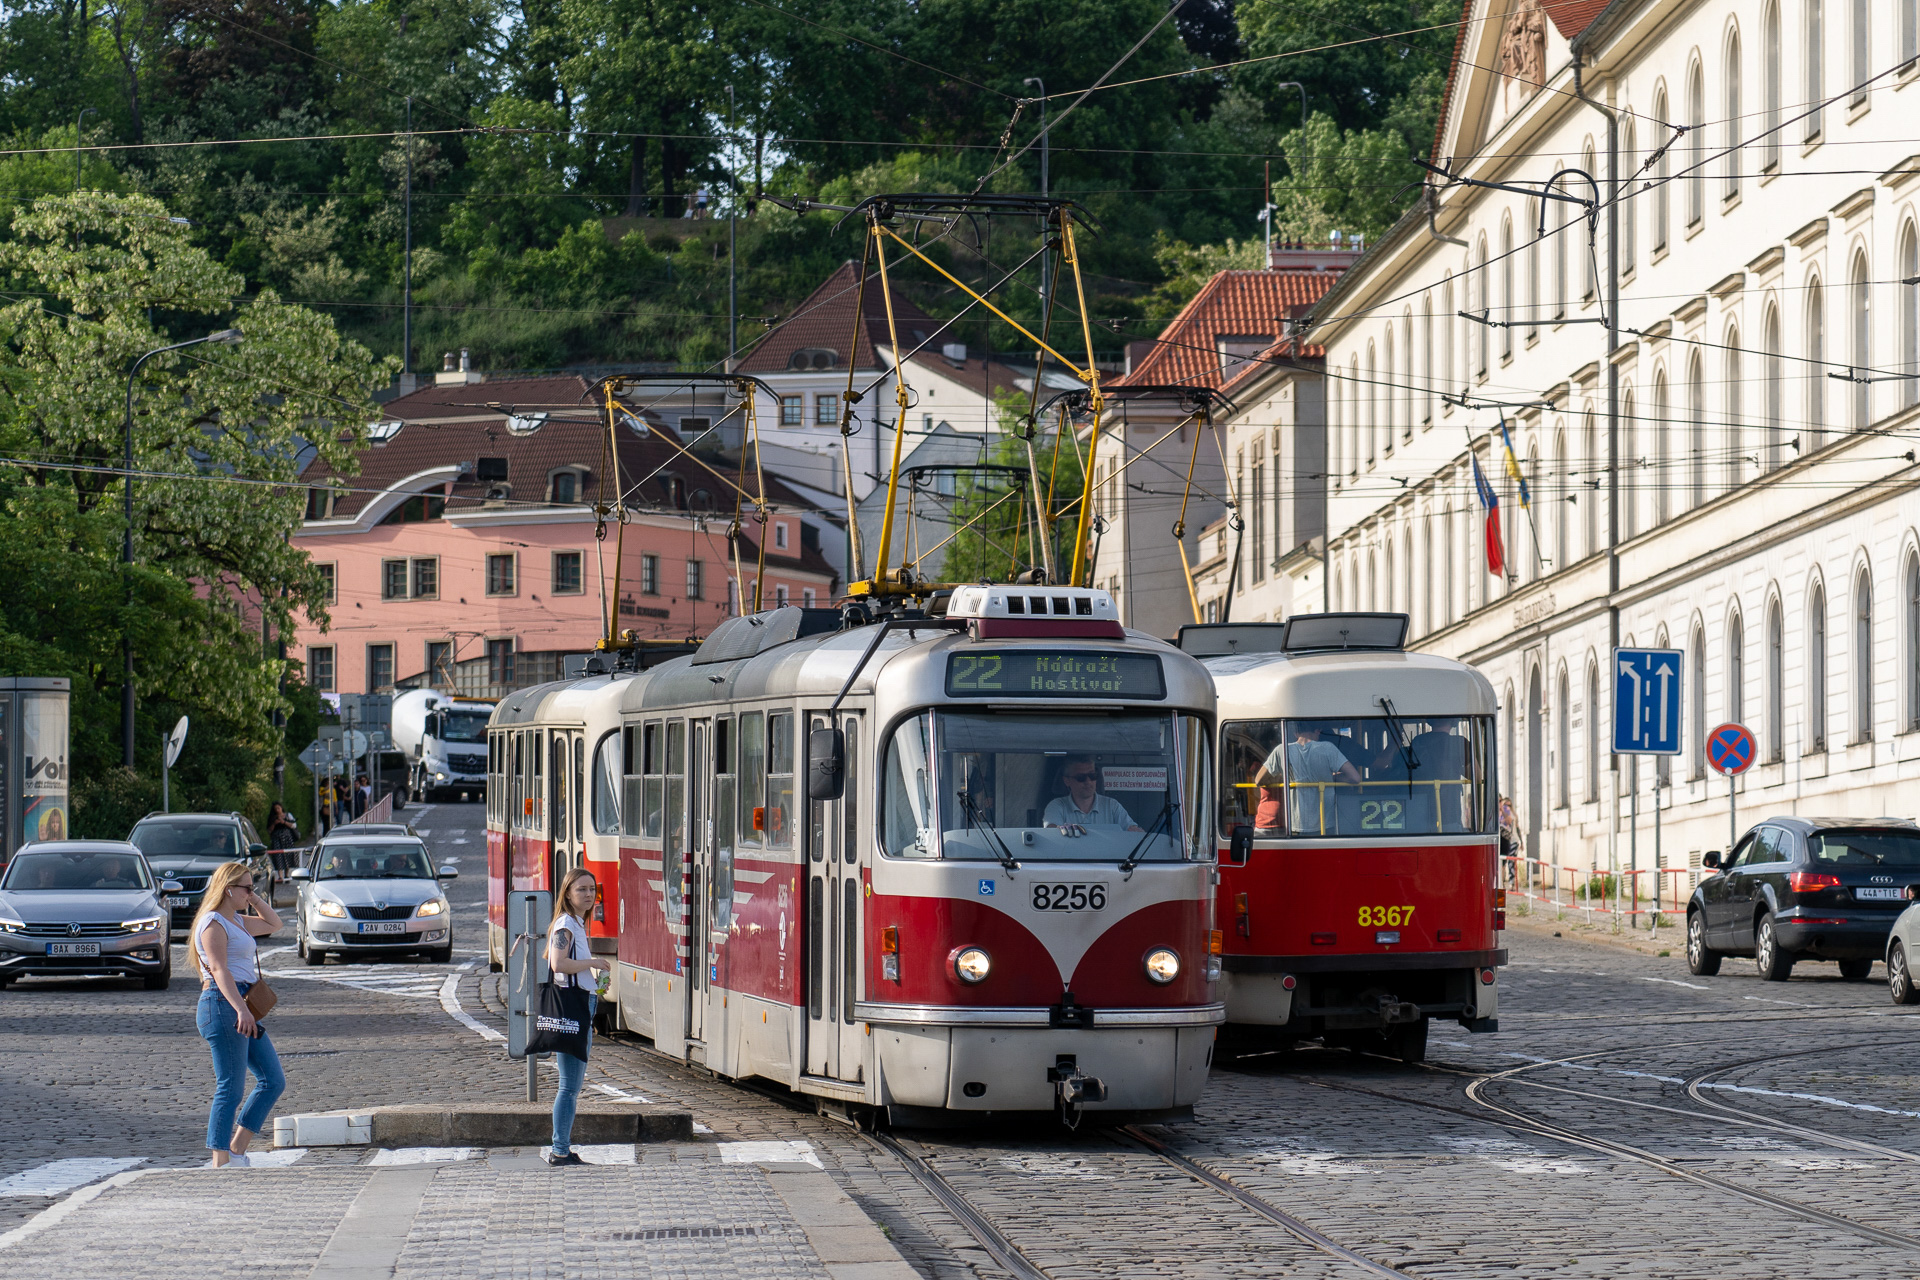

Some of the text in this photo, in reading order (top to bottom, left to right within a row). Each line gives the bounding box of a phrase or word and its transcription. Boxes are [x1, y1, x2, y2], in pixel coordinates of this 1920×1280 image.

[953, 655, 1118, 689] 22 Nádraží
[1031, 675, 1122, 691] Hostivař
[1119, 780, 1143, 788] STAŽENÝM
[1362, 801, 1402, 829] 22
[1032, 884, 1106, 911] 8256
[1358, 905, 1416, 927] 8367
[364, 923, 402, 932] 2AV 0284
[53, 944, 96, 953] 8AX 8966
